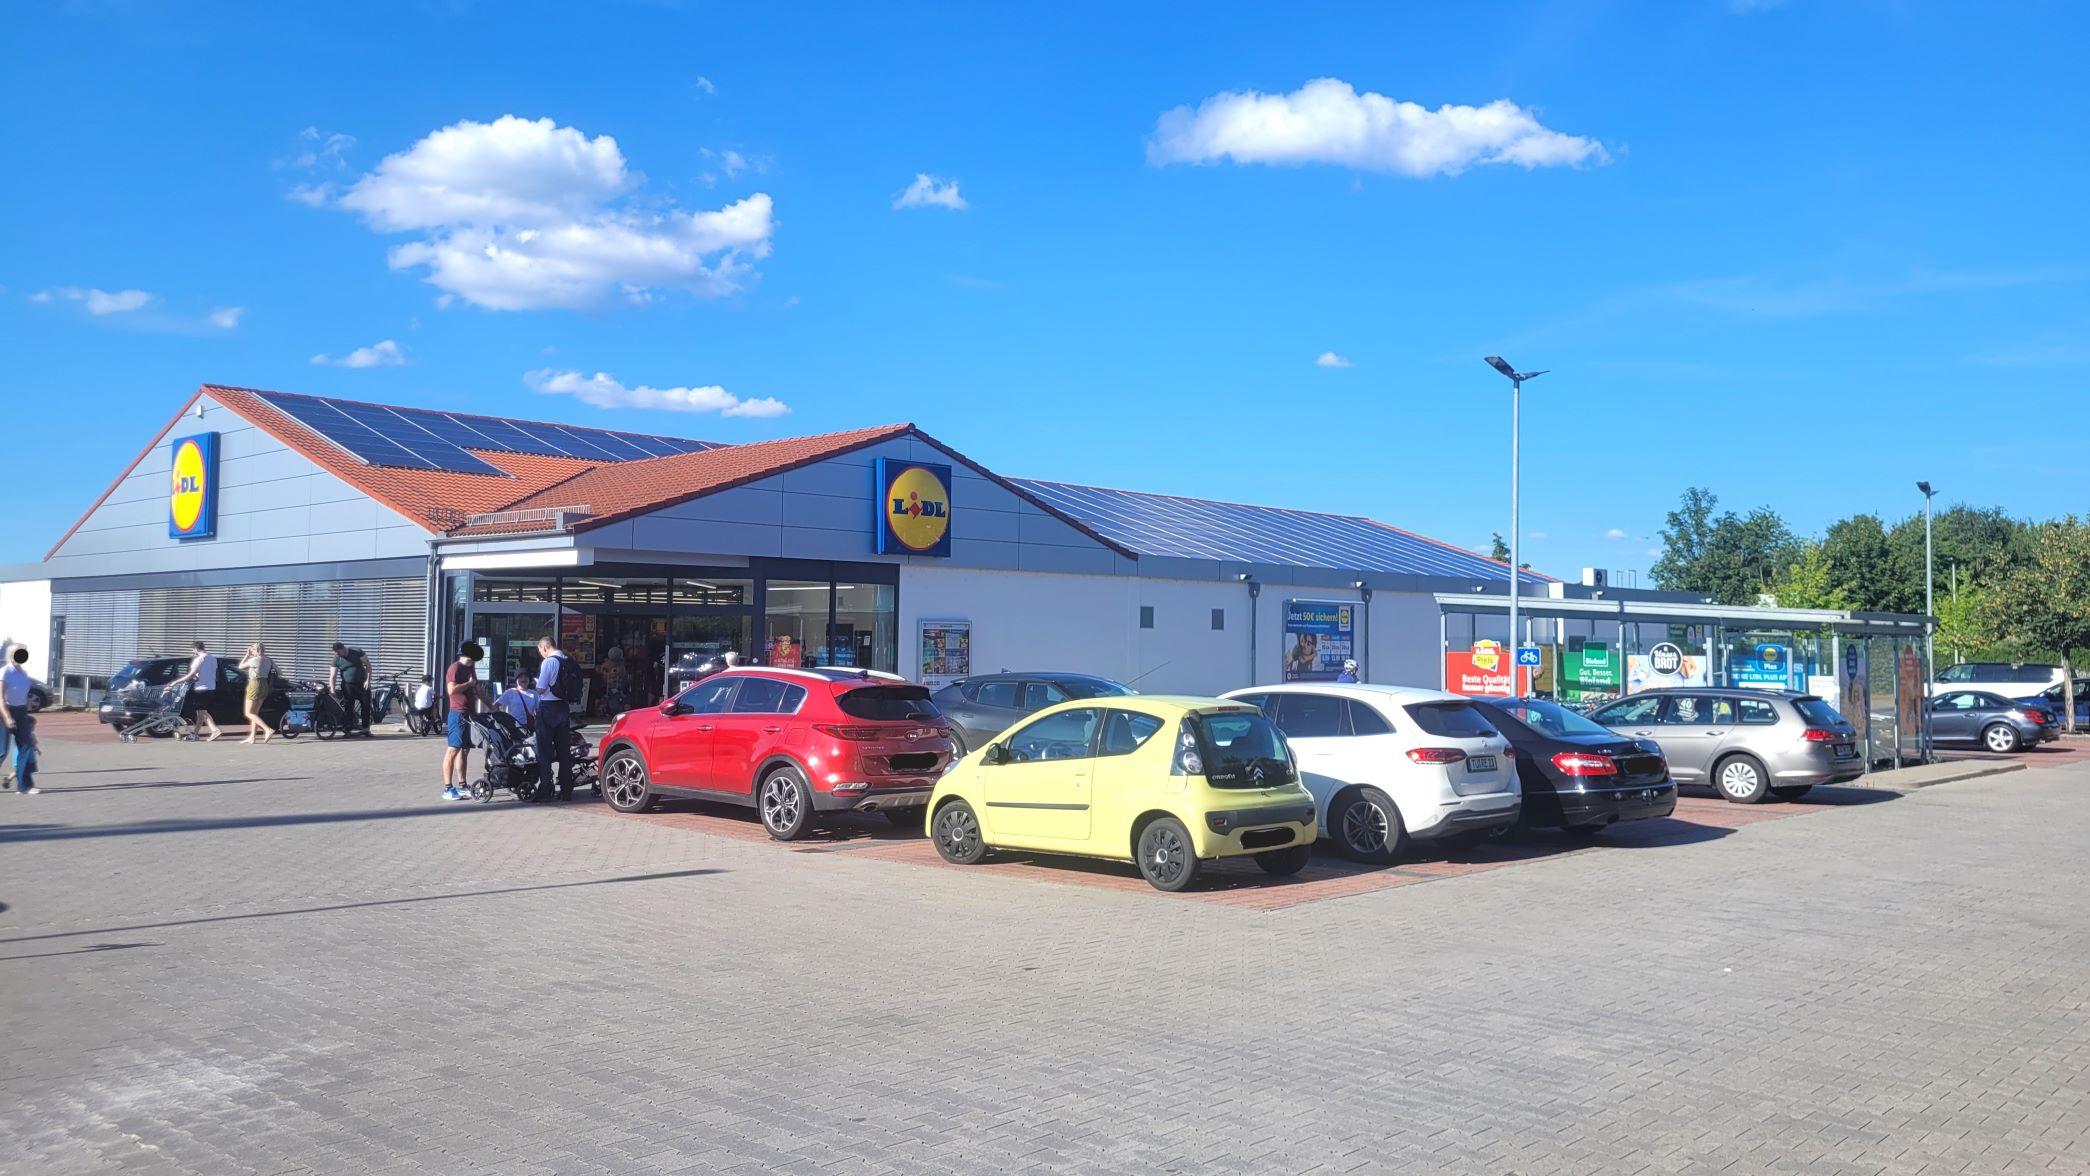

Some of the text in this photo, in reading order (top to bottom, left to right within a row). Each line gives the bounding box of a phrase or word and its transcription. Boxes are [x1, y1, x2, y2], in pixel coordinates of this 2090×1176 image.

[892, 491, 946, 519] LIDL
[1476, 656, 1494, 664] Preis
[1655, 657, 1678, 670] BROT
[1462, 674, 1481, 683] Beste
